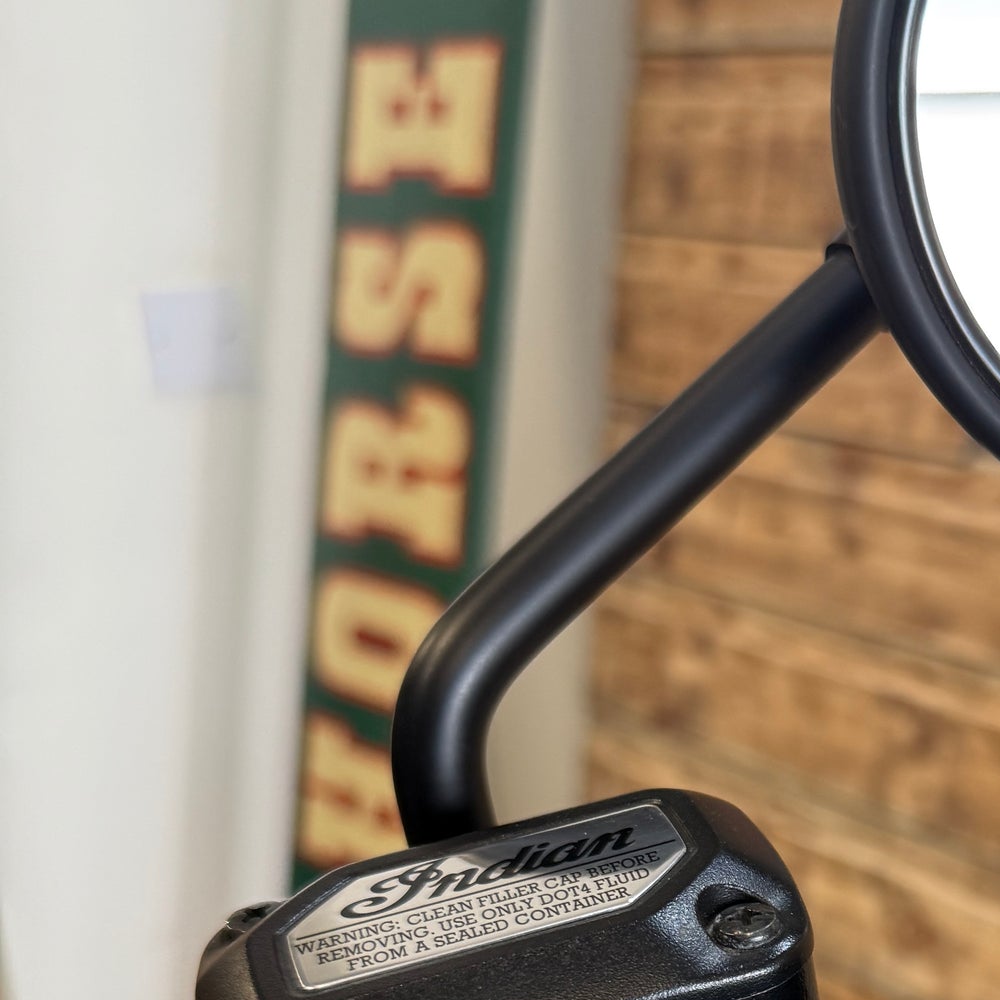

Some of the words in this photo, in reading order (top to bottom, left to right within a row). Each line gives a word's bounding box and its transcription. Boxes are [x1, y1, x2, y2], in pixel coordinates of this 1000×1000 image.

[296, 36, 505, 872] HORSE
[294, 920, 401, 955] WARNING:
[406, 899, 474, 926] CLEAN
[476, 882, 543, 908] FILLER
[544, 871, 583, 890] CAP
[586, 850, 661, 879] BEFORE
[316, 926, 436, 965] REMOVING.
[438, 913, 478, 932] USE
[481, 897, 535, 920] ONLY
[538, 882, 592, 906] DOT4
[594, 867, 650, 892] FLUID
[340, 826, 636, 919] Indian
[346, 946, 409, 971] FROM
[415, 940, 431, 954] A
[433, 919, 509, 949] SEALED
[514, 886, 632, 926] CONTAINER
